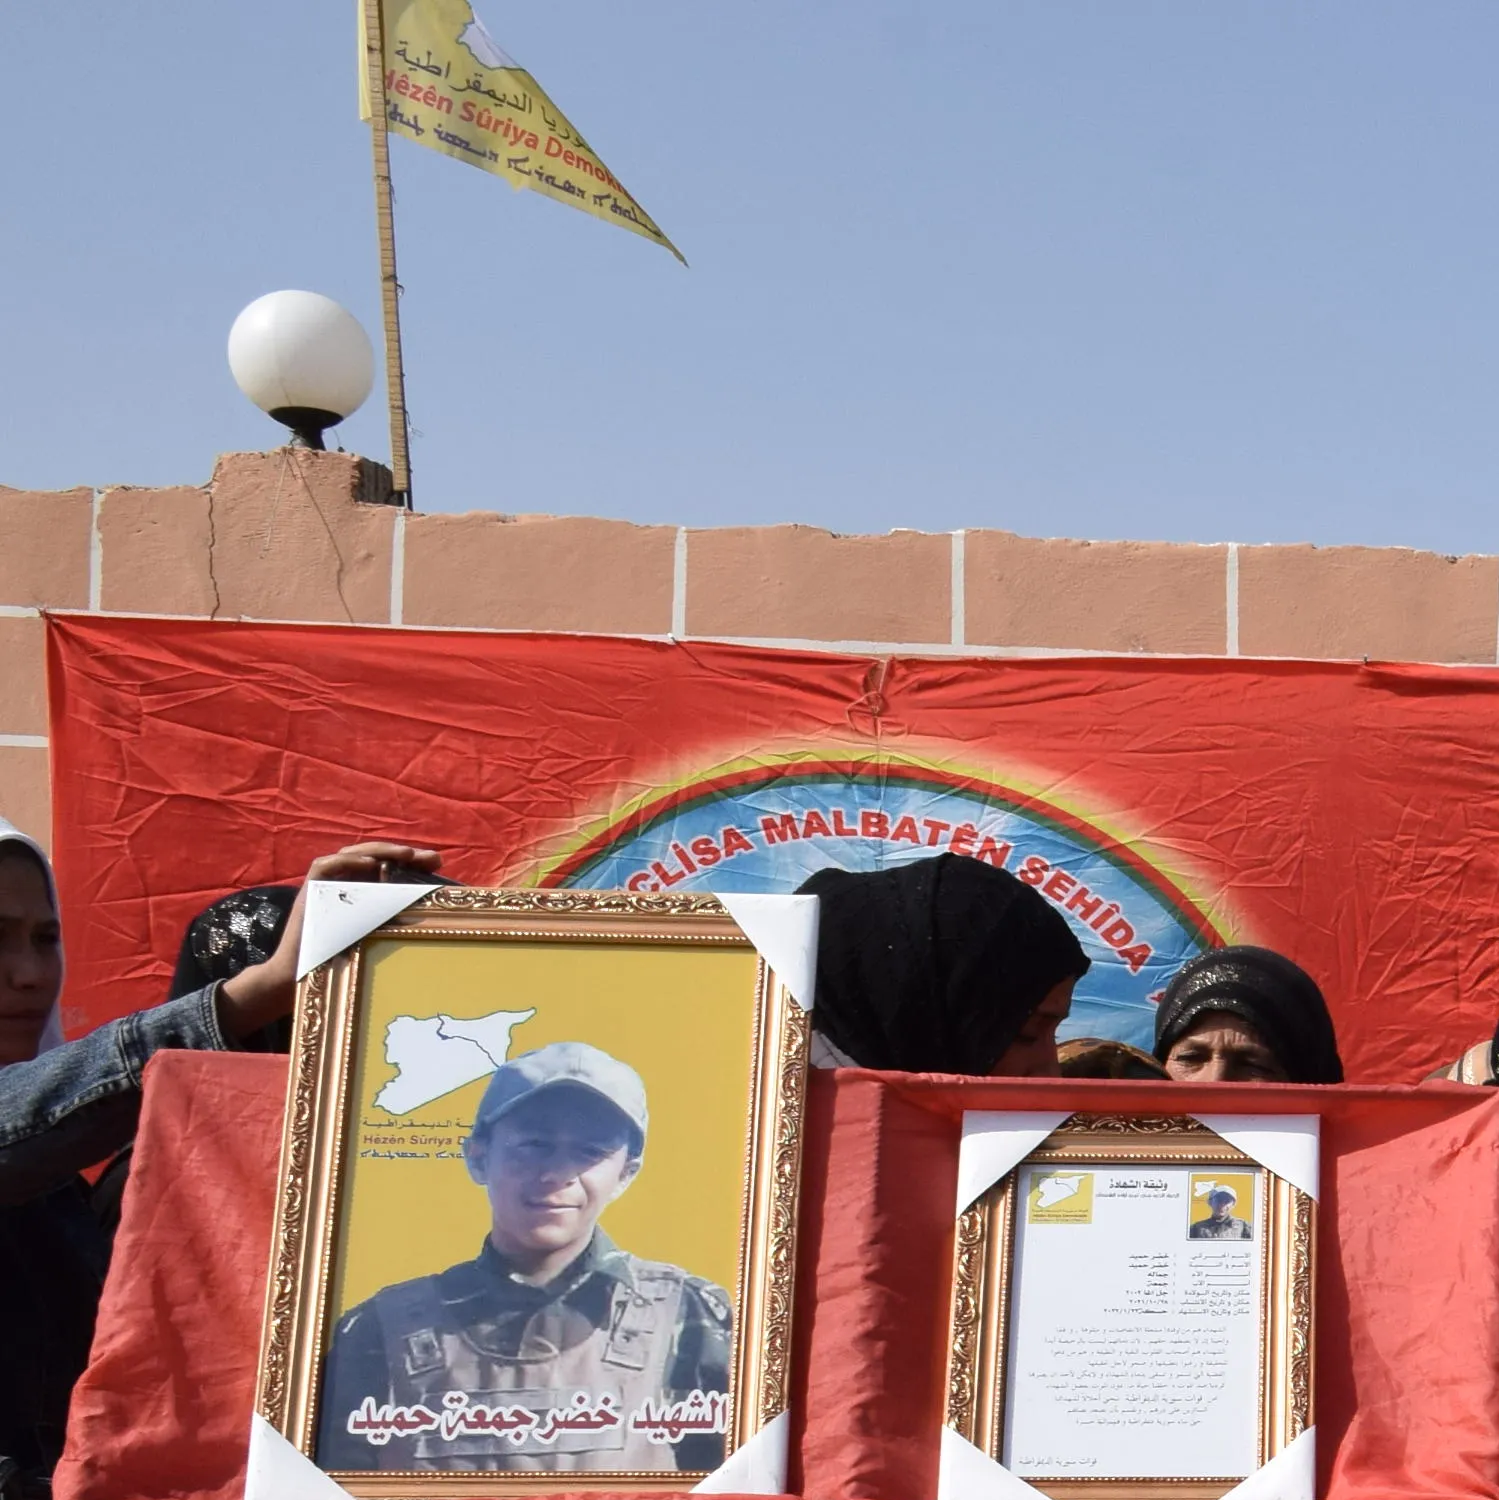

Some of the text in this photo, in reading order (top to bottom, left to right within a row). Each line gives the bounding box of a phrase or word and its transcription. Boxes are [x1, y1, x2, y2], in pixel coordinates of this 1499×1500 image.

[460, 99, 540, 151] Sûriya
[544, 136, 630, 198] Demok
[760, 809, 1013, 869] MALBATÊN
[349, 1391, 729, 1444] الشهيد خضر جمعة حميد
